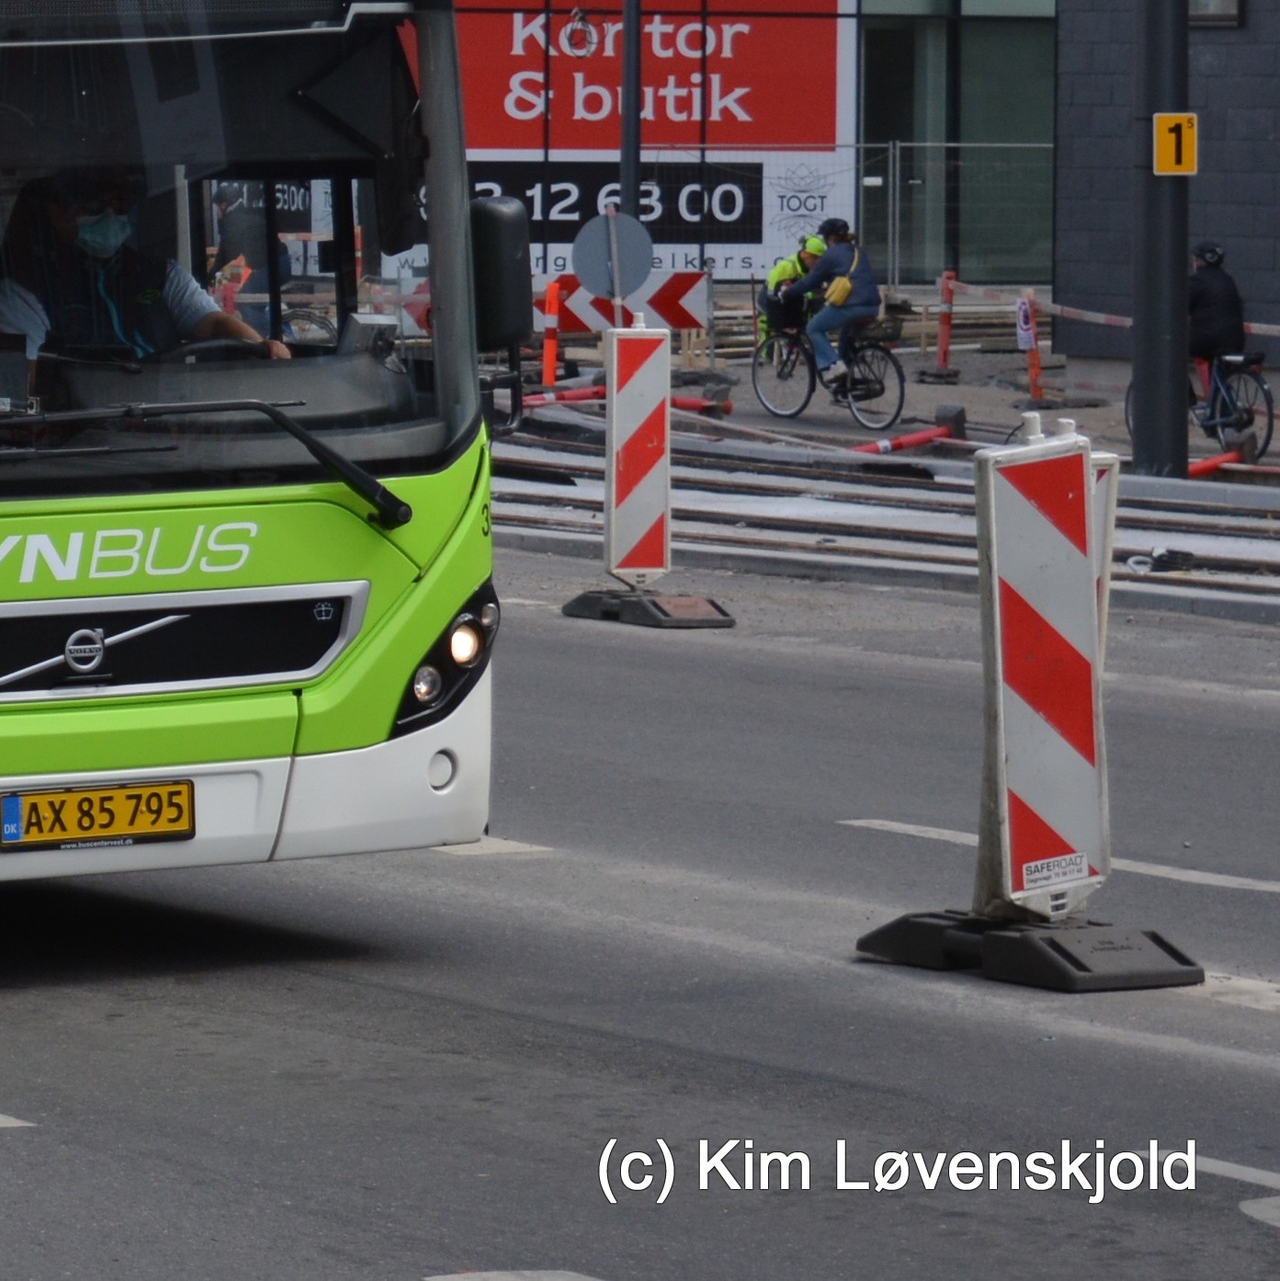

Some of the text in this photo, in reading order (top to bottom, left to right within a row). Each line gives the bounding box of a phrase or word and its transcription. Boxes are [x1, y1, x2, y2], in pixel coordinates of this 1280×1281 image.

[504, 71, 553, 120] &
[1168, 122, 1183, 166] 1
[525, 183, 580, 221] 12
[678, 183, 744, 223] 00
[777, 194, 827, 212] TOGT
[4, 823, 17, 835] DK
[23, 790, 184, 835] AX 85 795
